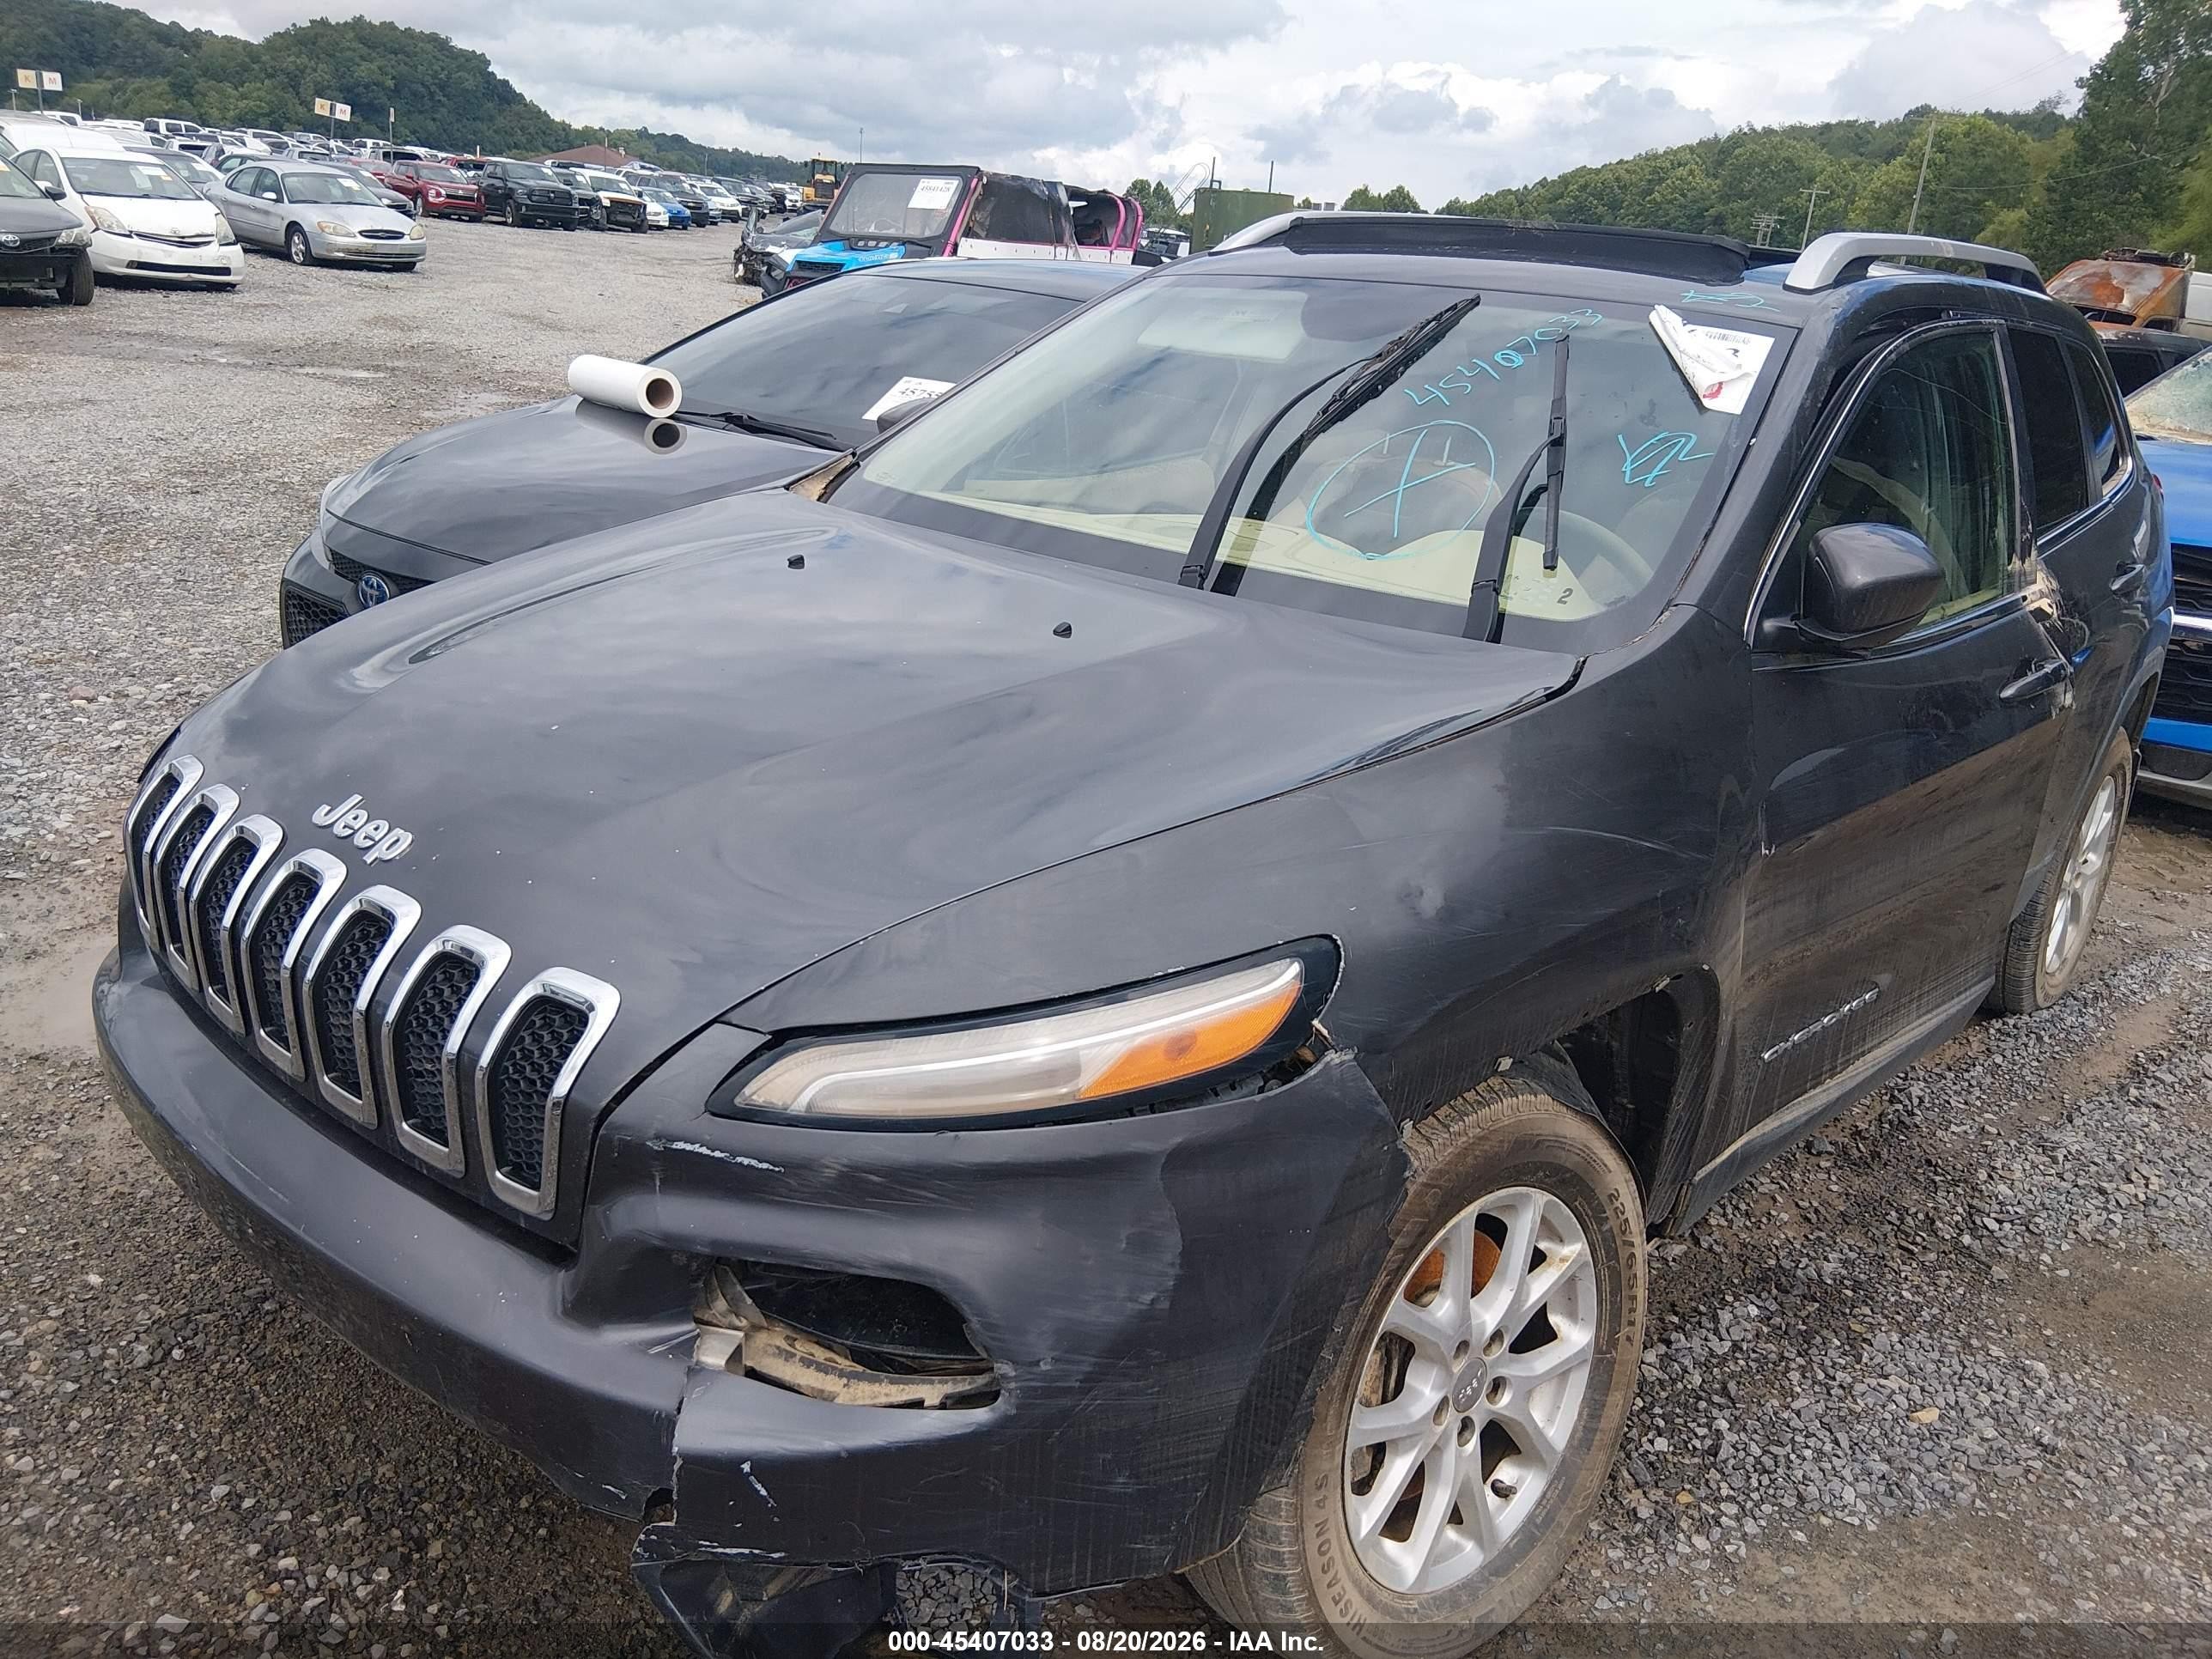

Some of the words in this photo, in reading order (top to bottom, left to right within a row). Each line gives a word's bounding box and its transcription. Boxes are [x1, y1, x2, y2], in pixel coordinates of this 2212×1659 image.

[24, 75, 31, 83] K
[48, 76, 57, 85] M
[1403, 308, 1603, 407] 45407033
[312, 793, 413, 866] Jeep
